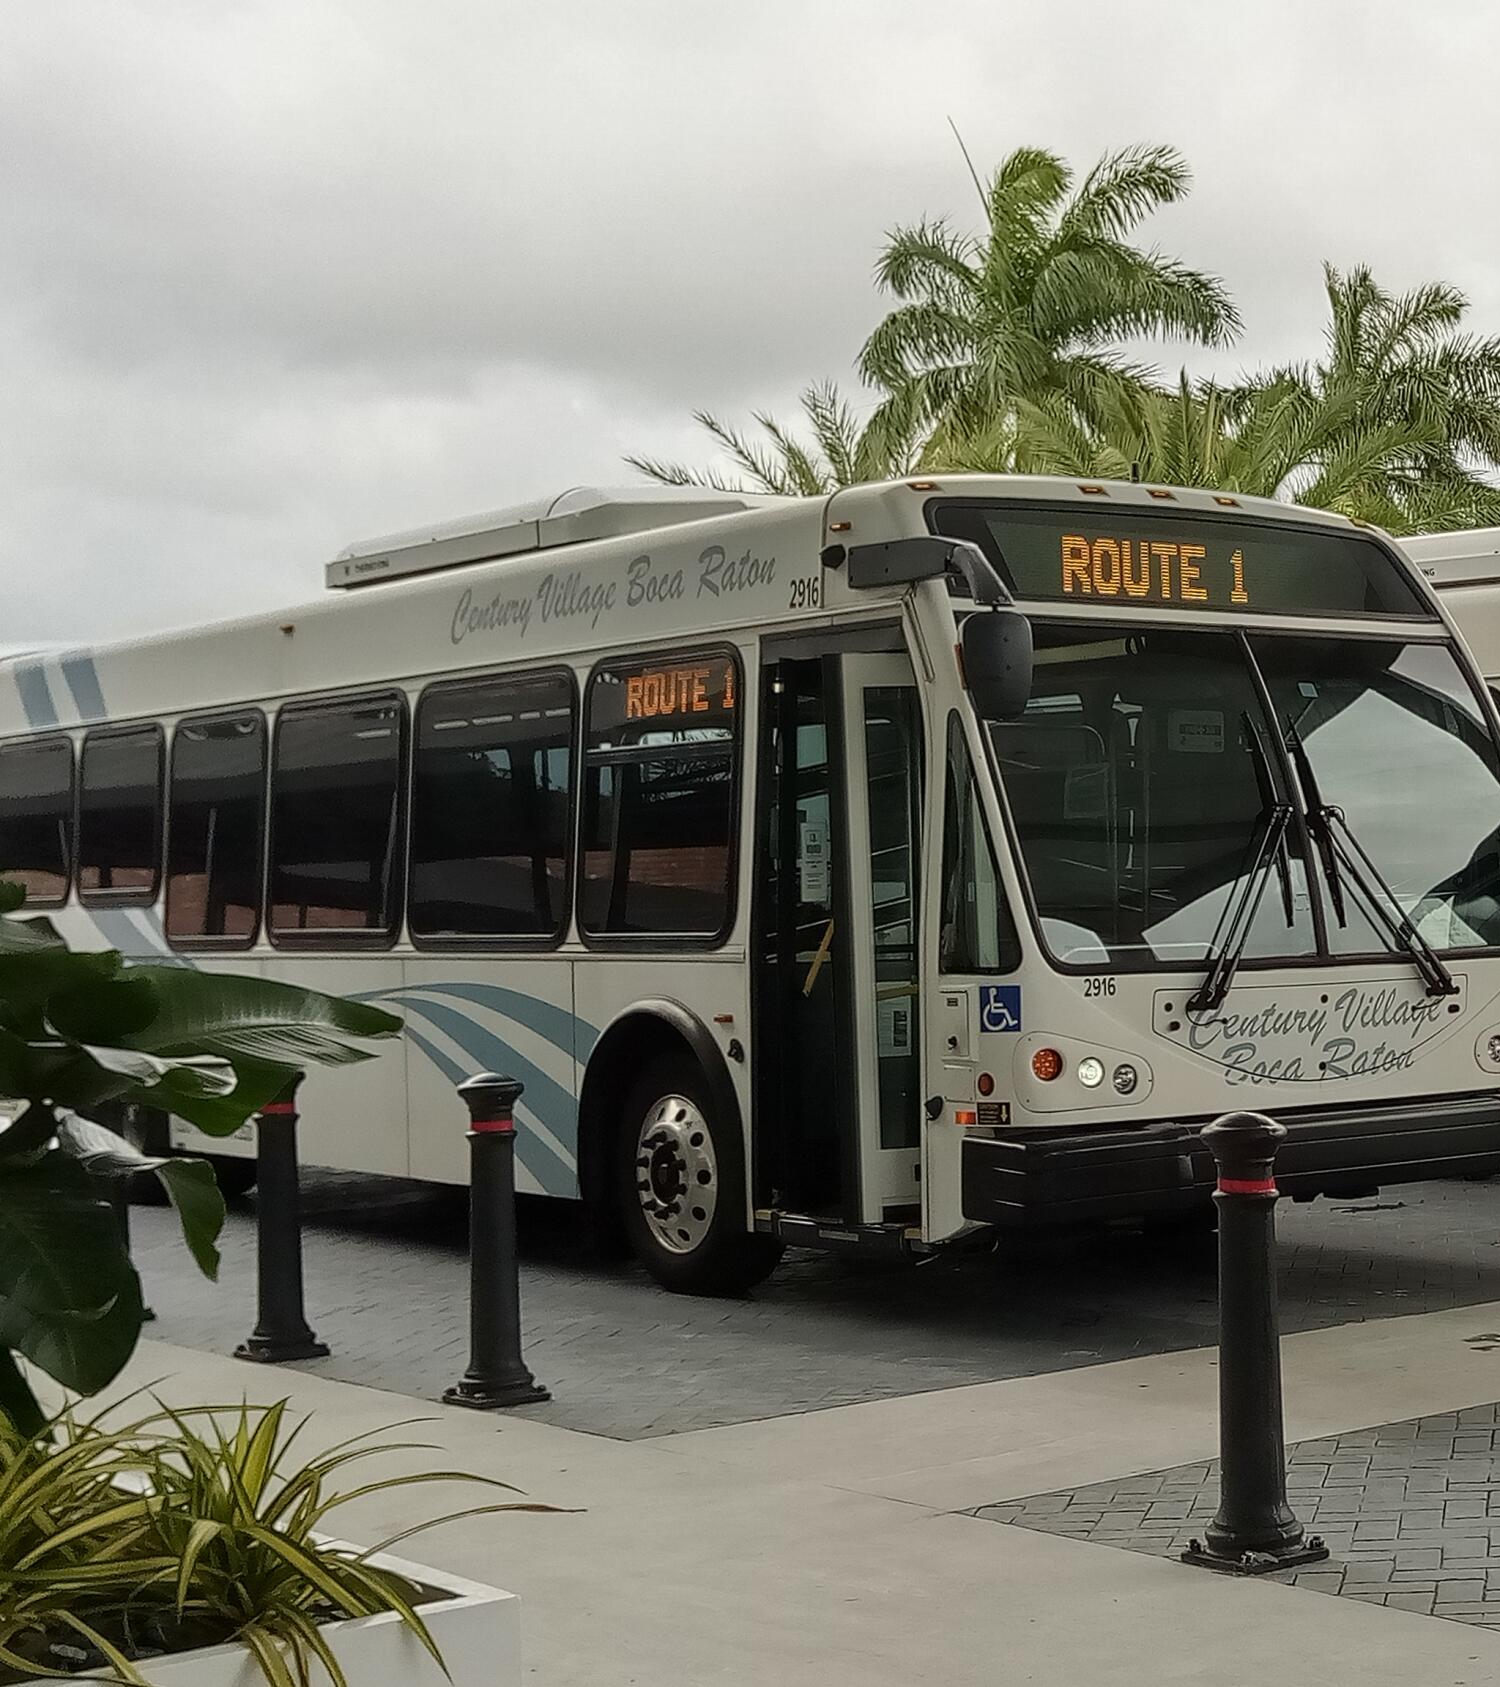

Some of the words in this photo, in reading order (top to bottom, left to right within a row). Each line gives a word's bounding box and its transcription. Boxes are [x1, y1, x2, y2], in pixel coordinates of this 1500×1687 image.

[451, 588, 533, 645] Century
[537, 573, 616, 629] Village
[626, 554, 685, 608] Boca
[696, 544, 776, 598] Raton
[789, 577, 820, 609] 2916
[1061, 534, 1208, 601] ROUTE
[1229, 549, 1249, 604] 1
[626, 669, 711, 720] ROUTE
[722, 665, 735, 709] 1
[1083, 976, 1117, 998] 2916
[1189, 1001, 1328, 1050] Century
[1334, 988, 1442, 1039] Village
[1222, 1042, 1305, 1086] Boca
[1319, 1037, 1415, 1081] Raton
